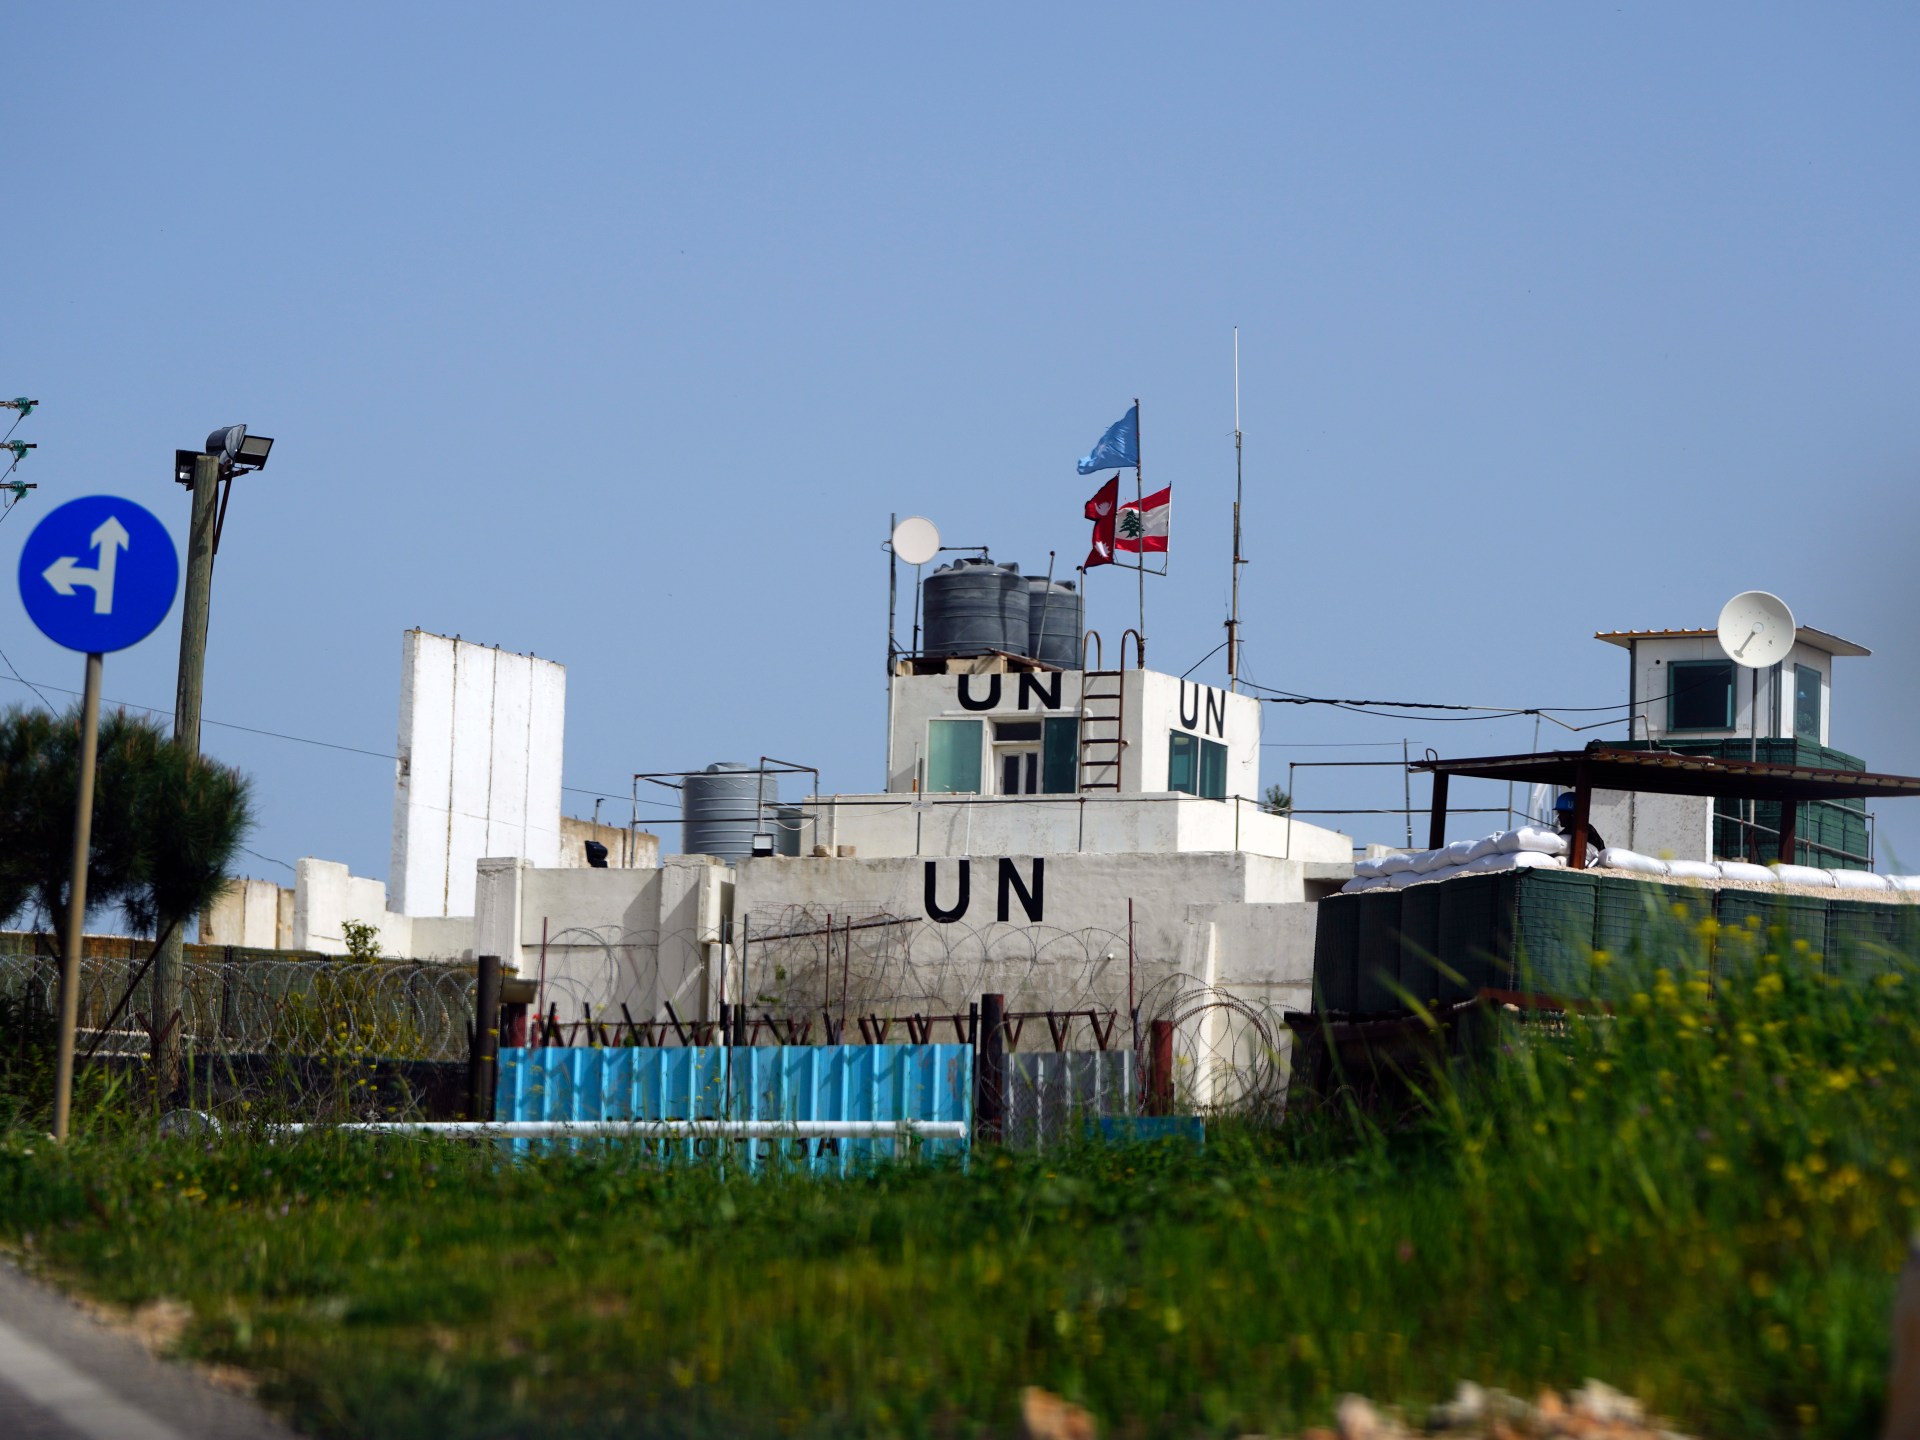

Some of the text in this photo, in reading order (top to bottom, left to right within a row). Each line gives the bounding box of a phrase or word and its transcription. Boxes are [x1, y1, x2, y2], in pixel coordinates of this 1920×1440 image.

[957, 672, 1063, 712] UN
[1179, 679, 1226, 739] UN
[924, 857, 1045, 924] UN
